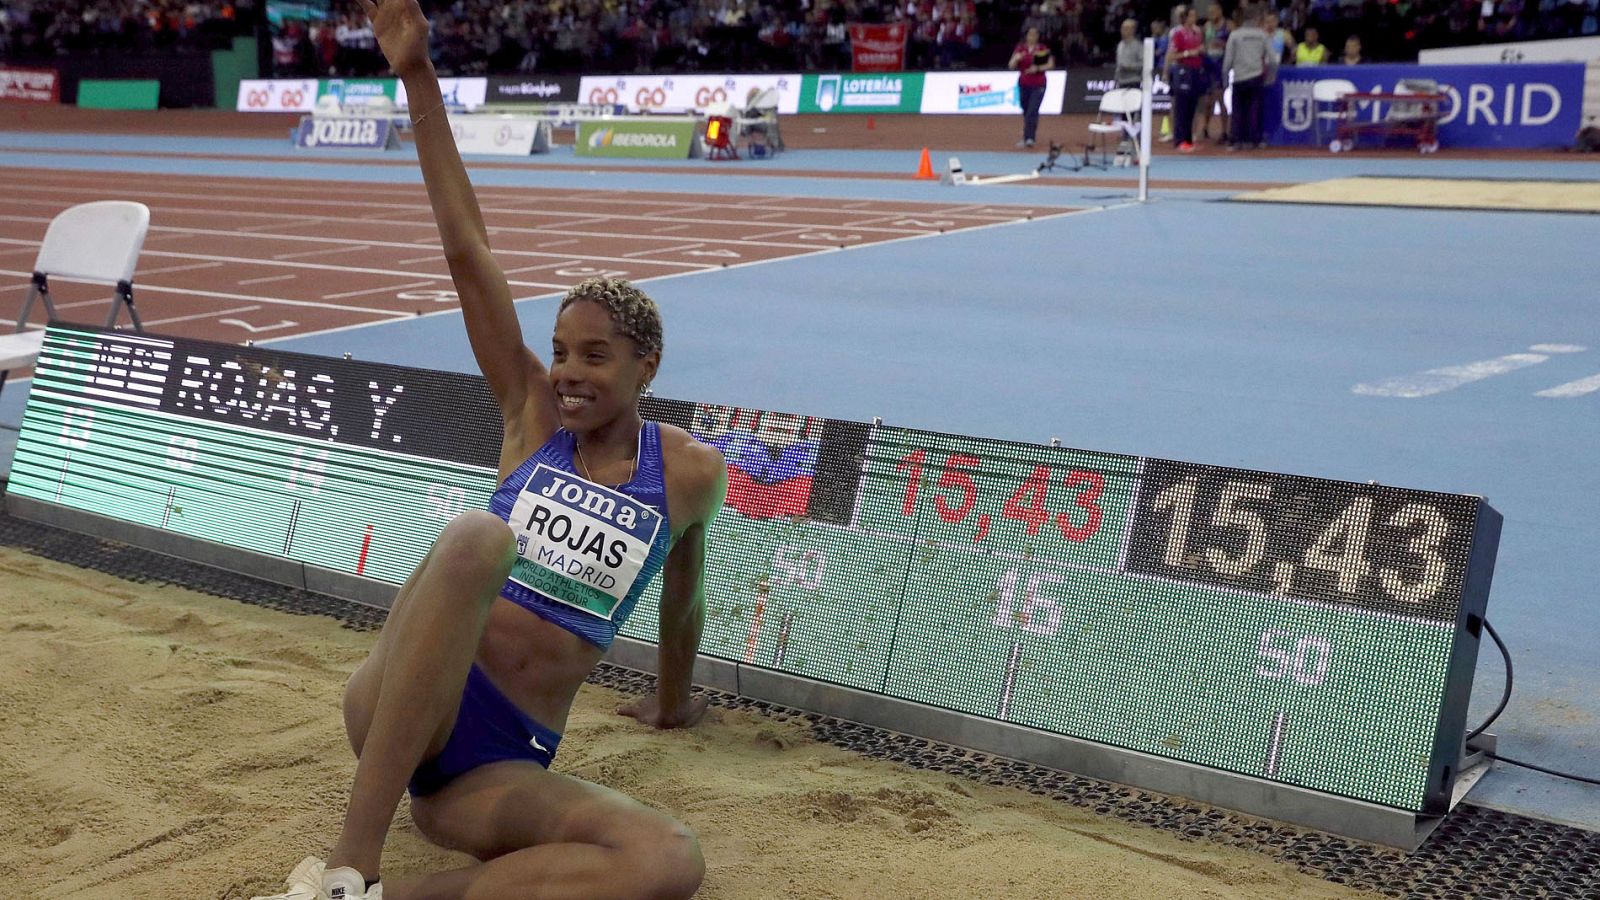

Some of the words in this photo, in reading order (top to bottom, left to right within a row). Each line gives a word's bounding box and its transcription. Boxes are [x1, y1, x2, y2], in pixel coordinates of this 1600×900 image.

[635, 87, 666, 106] GO
[843, 77, 902, 92] LOTERÍAS
[612, 134, 677, 147] IBERDROLA
[177, 356, 338, 442] ROJAS,
[369, 381, 404, 443] Y.
[896, 449, 1104, 543] 15,43
[526, 504, 628, 569] ROJAS
[1152, 475, 1450, 603] 15,43
[519, 571, 559, 596] INDOOR
[560, 588, 589, 607] TOUR
[538, 545, 616, 589] MADRID
[547, 571, 600, 600] ATHLETICS
[992, 570, 1064, 636] 16
[1256, 628, 1332, 686] 50
[331, 886, 346, 896] NIKE
